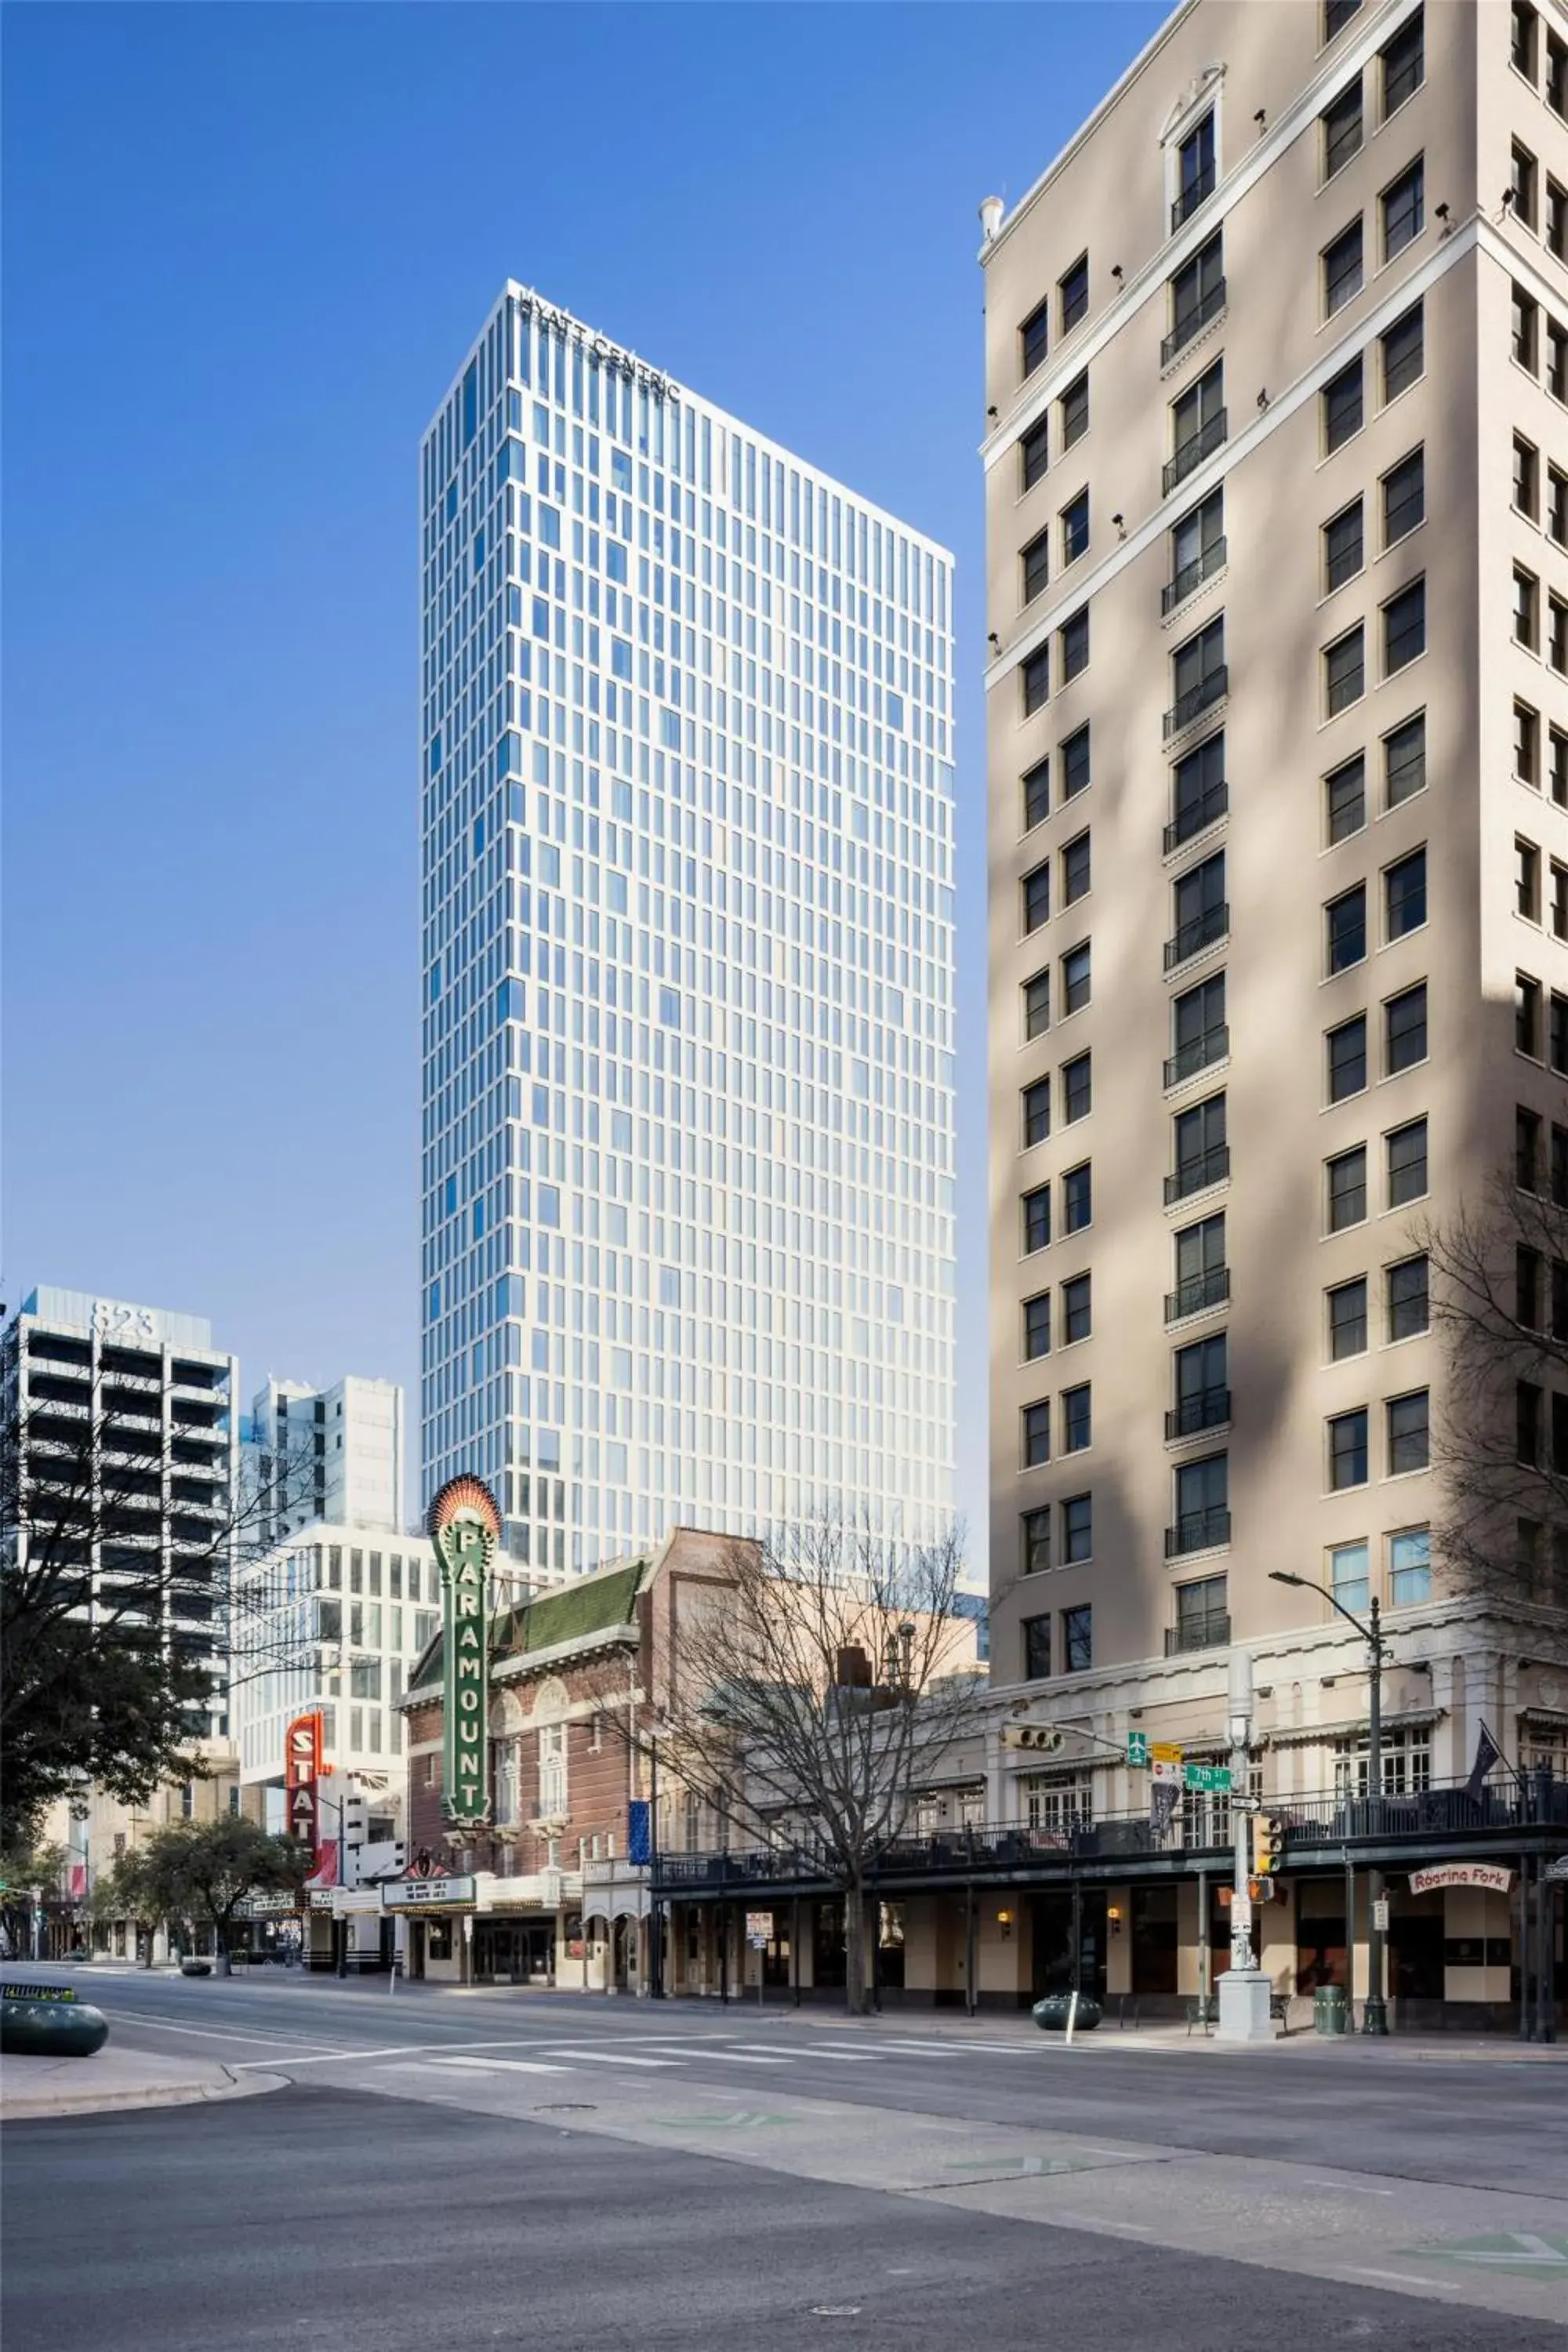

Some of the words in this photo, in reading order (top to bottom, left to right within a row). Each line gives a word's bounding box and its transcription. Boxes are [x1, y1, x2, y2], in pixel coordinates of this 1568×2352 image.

[520, 289, 587, 343] HYATT
[592, 338, 681, 403] CENTRIC
[90, 1298, 156, 1339] 823
[456, 1530, 481, 1809] PARAMOUNT
[1194, 1767, 1212, 1781] 7th
[1472, 1867, 1504, 1886] Fork
